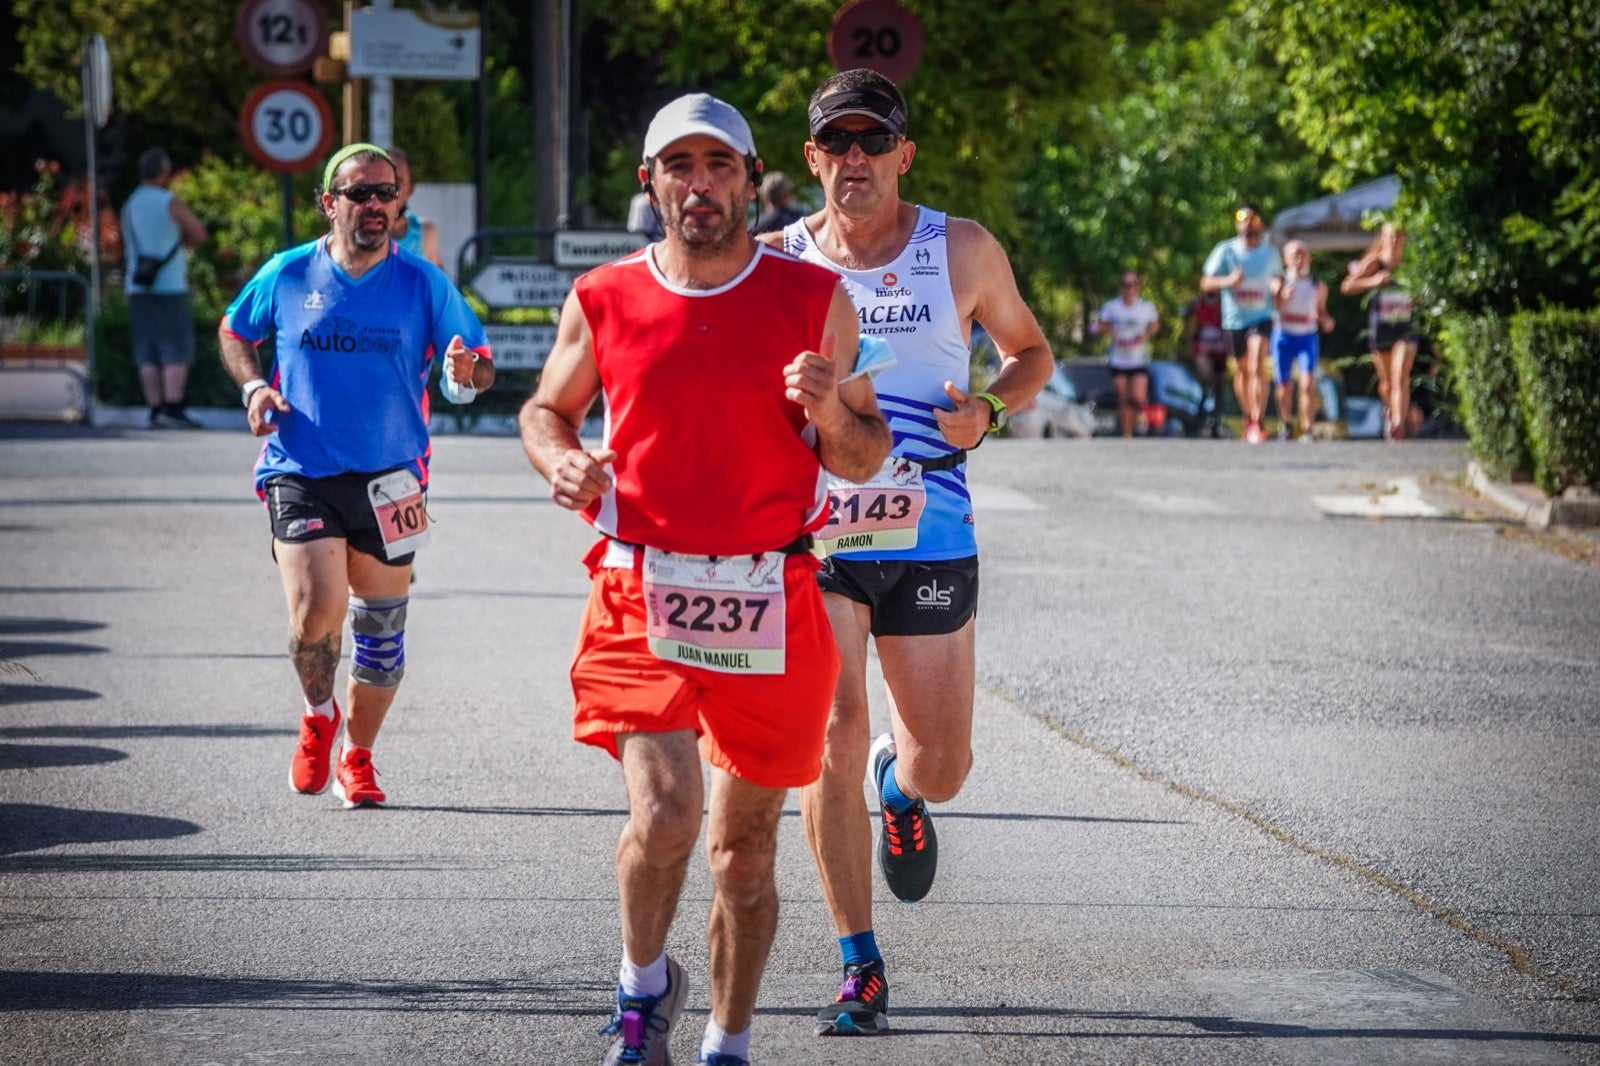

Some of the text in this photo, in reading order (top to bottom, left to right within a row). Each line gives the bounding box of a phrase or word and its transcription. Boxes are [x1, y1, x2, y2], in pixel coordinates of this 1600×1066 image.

[852, 26, 901, 59] 20
[264, 107, 311, 143] 30
[875, 286, 912, 298] mayfo
[860, 326, 917, 335] ATLETISMO
[826, 493, 912, 525] 2143
[836, 534, 874, 549] RAMON
[664, 592, 770, 633] 2237
[677, 644, 752, 669] JUAN MANUEL
